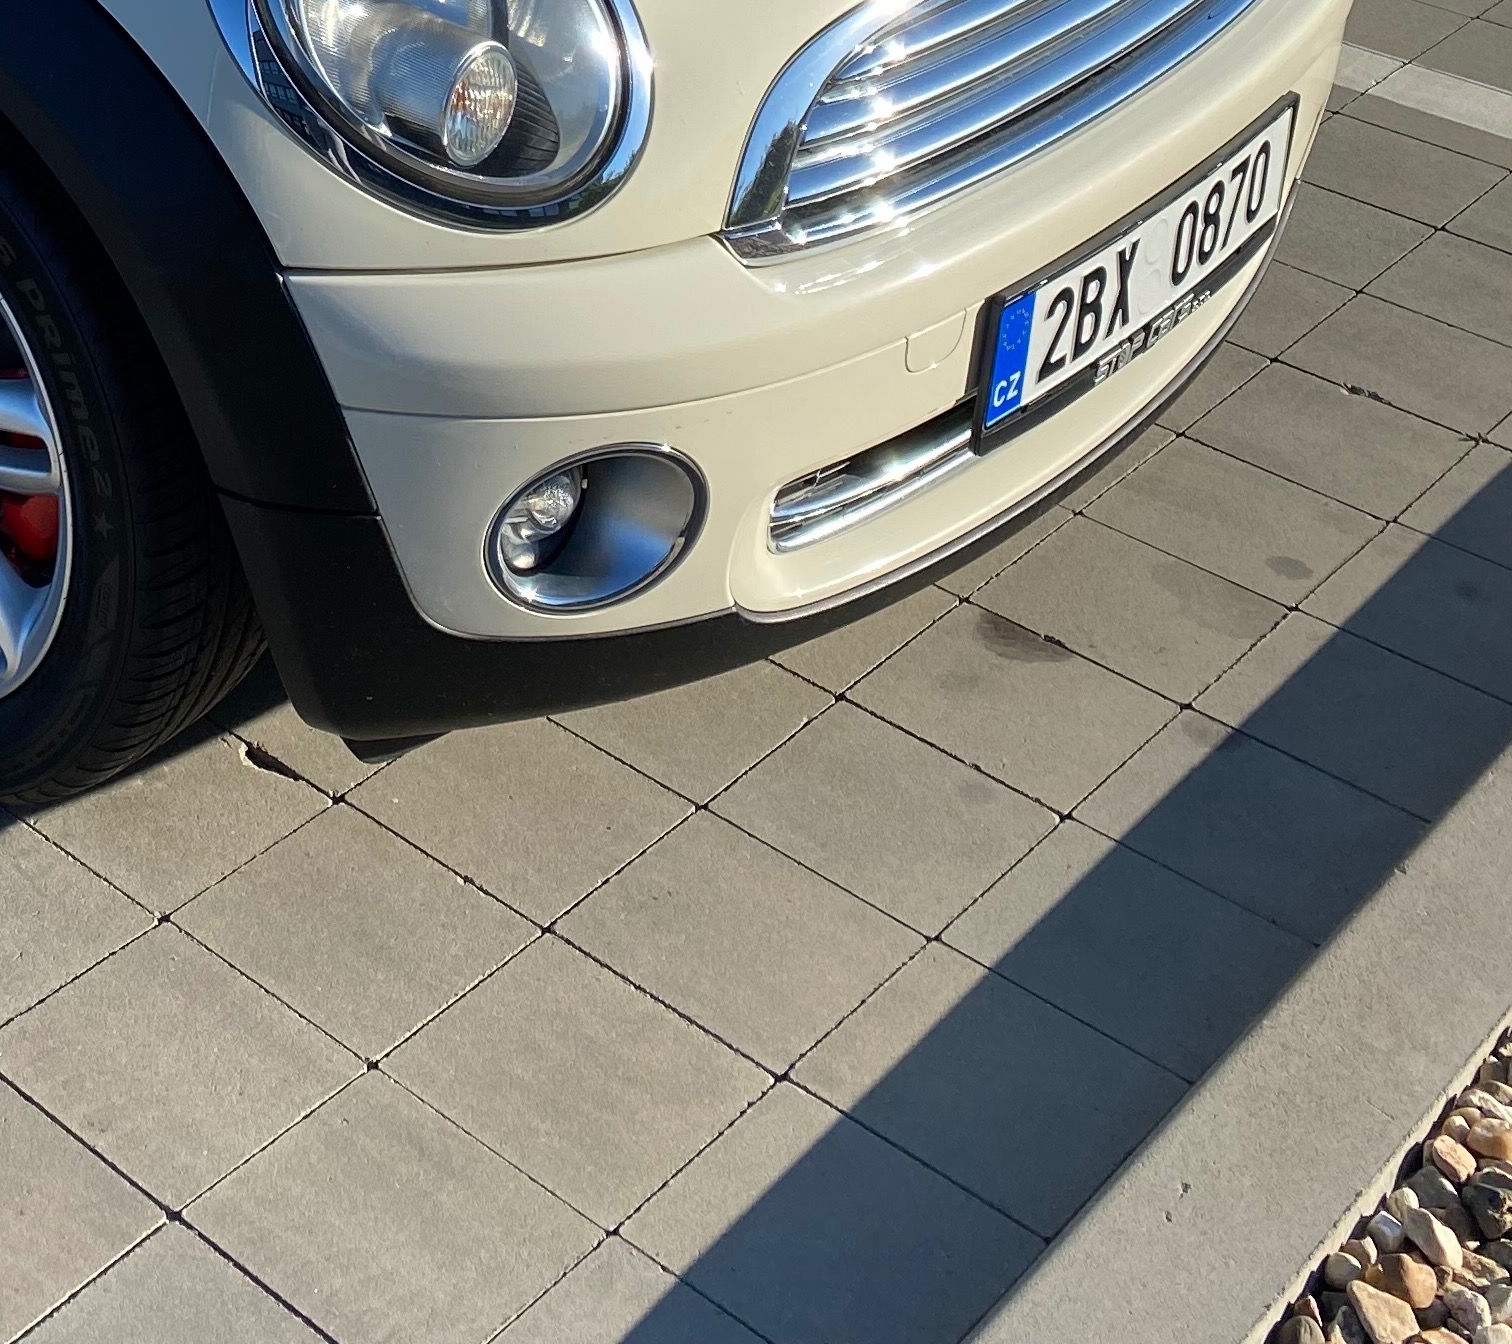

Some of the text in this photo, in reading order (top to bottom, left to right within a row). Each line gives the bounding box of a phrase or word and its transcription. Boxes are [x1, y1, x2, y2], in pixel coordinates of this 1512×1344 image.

[1035, 237, 1142, 385] 2BX
[1170, 138, 1272, 288] 0870
[992, 369, 1022, 409] CZ
